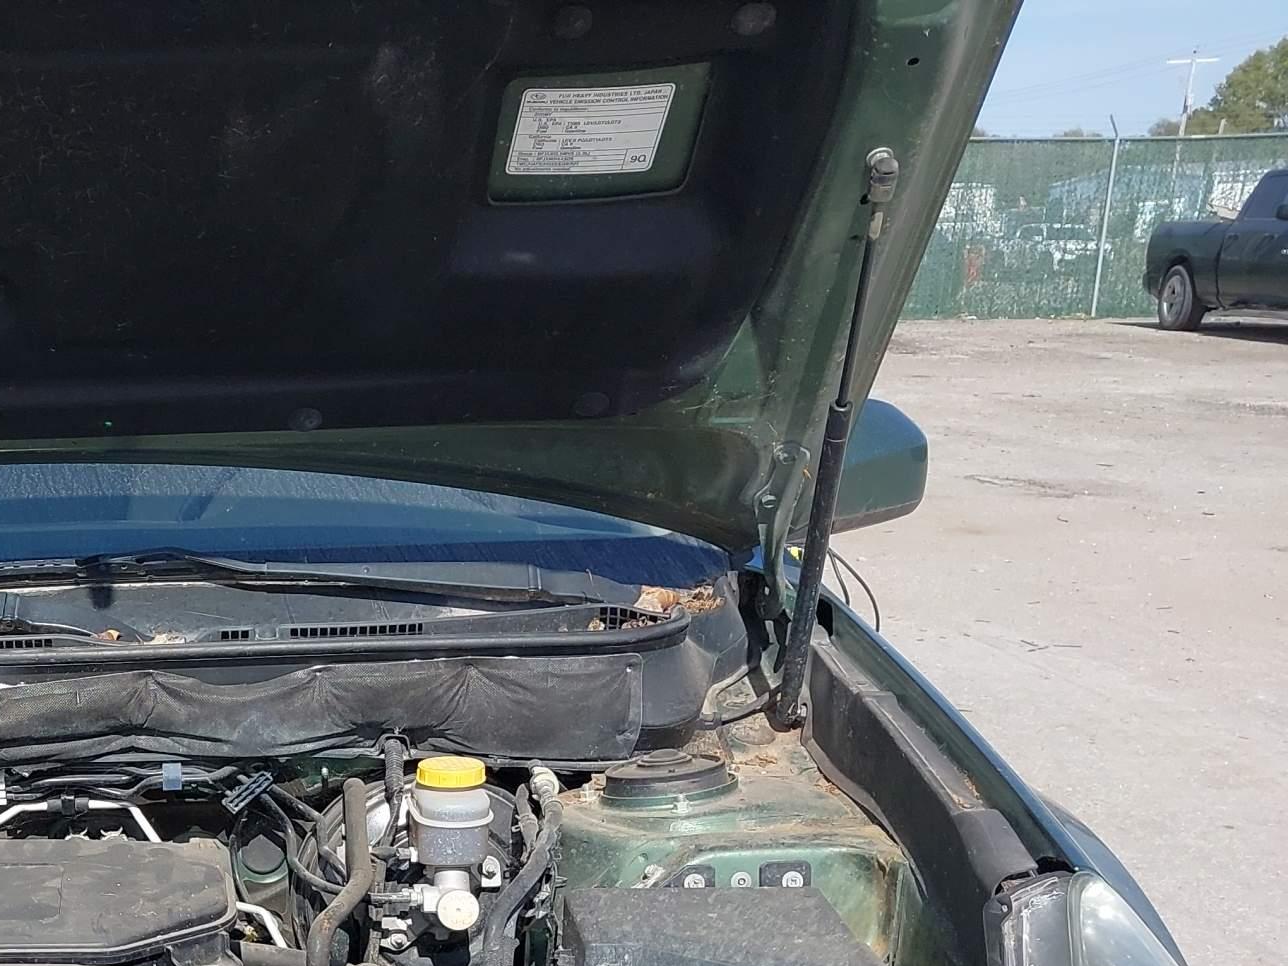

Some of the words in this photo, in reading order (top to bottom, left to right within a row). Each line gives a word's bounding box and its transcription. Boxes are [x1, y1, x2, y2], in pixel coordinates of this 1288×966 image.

[593, 90, 628, 98] INDUSTRIES
[630, 94, 669, 102] INFORMATION
[630, 154, 646, 164] 9Q
